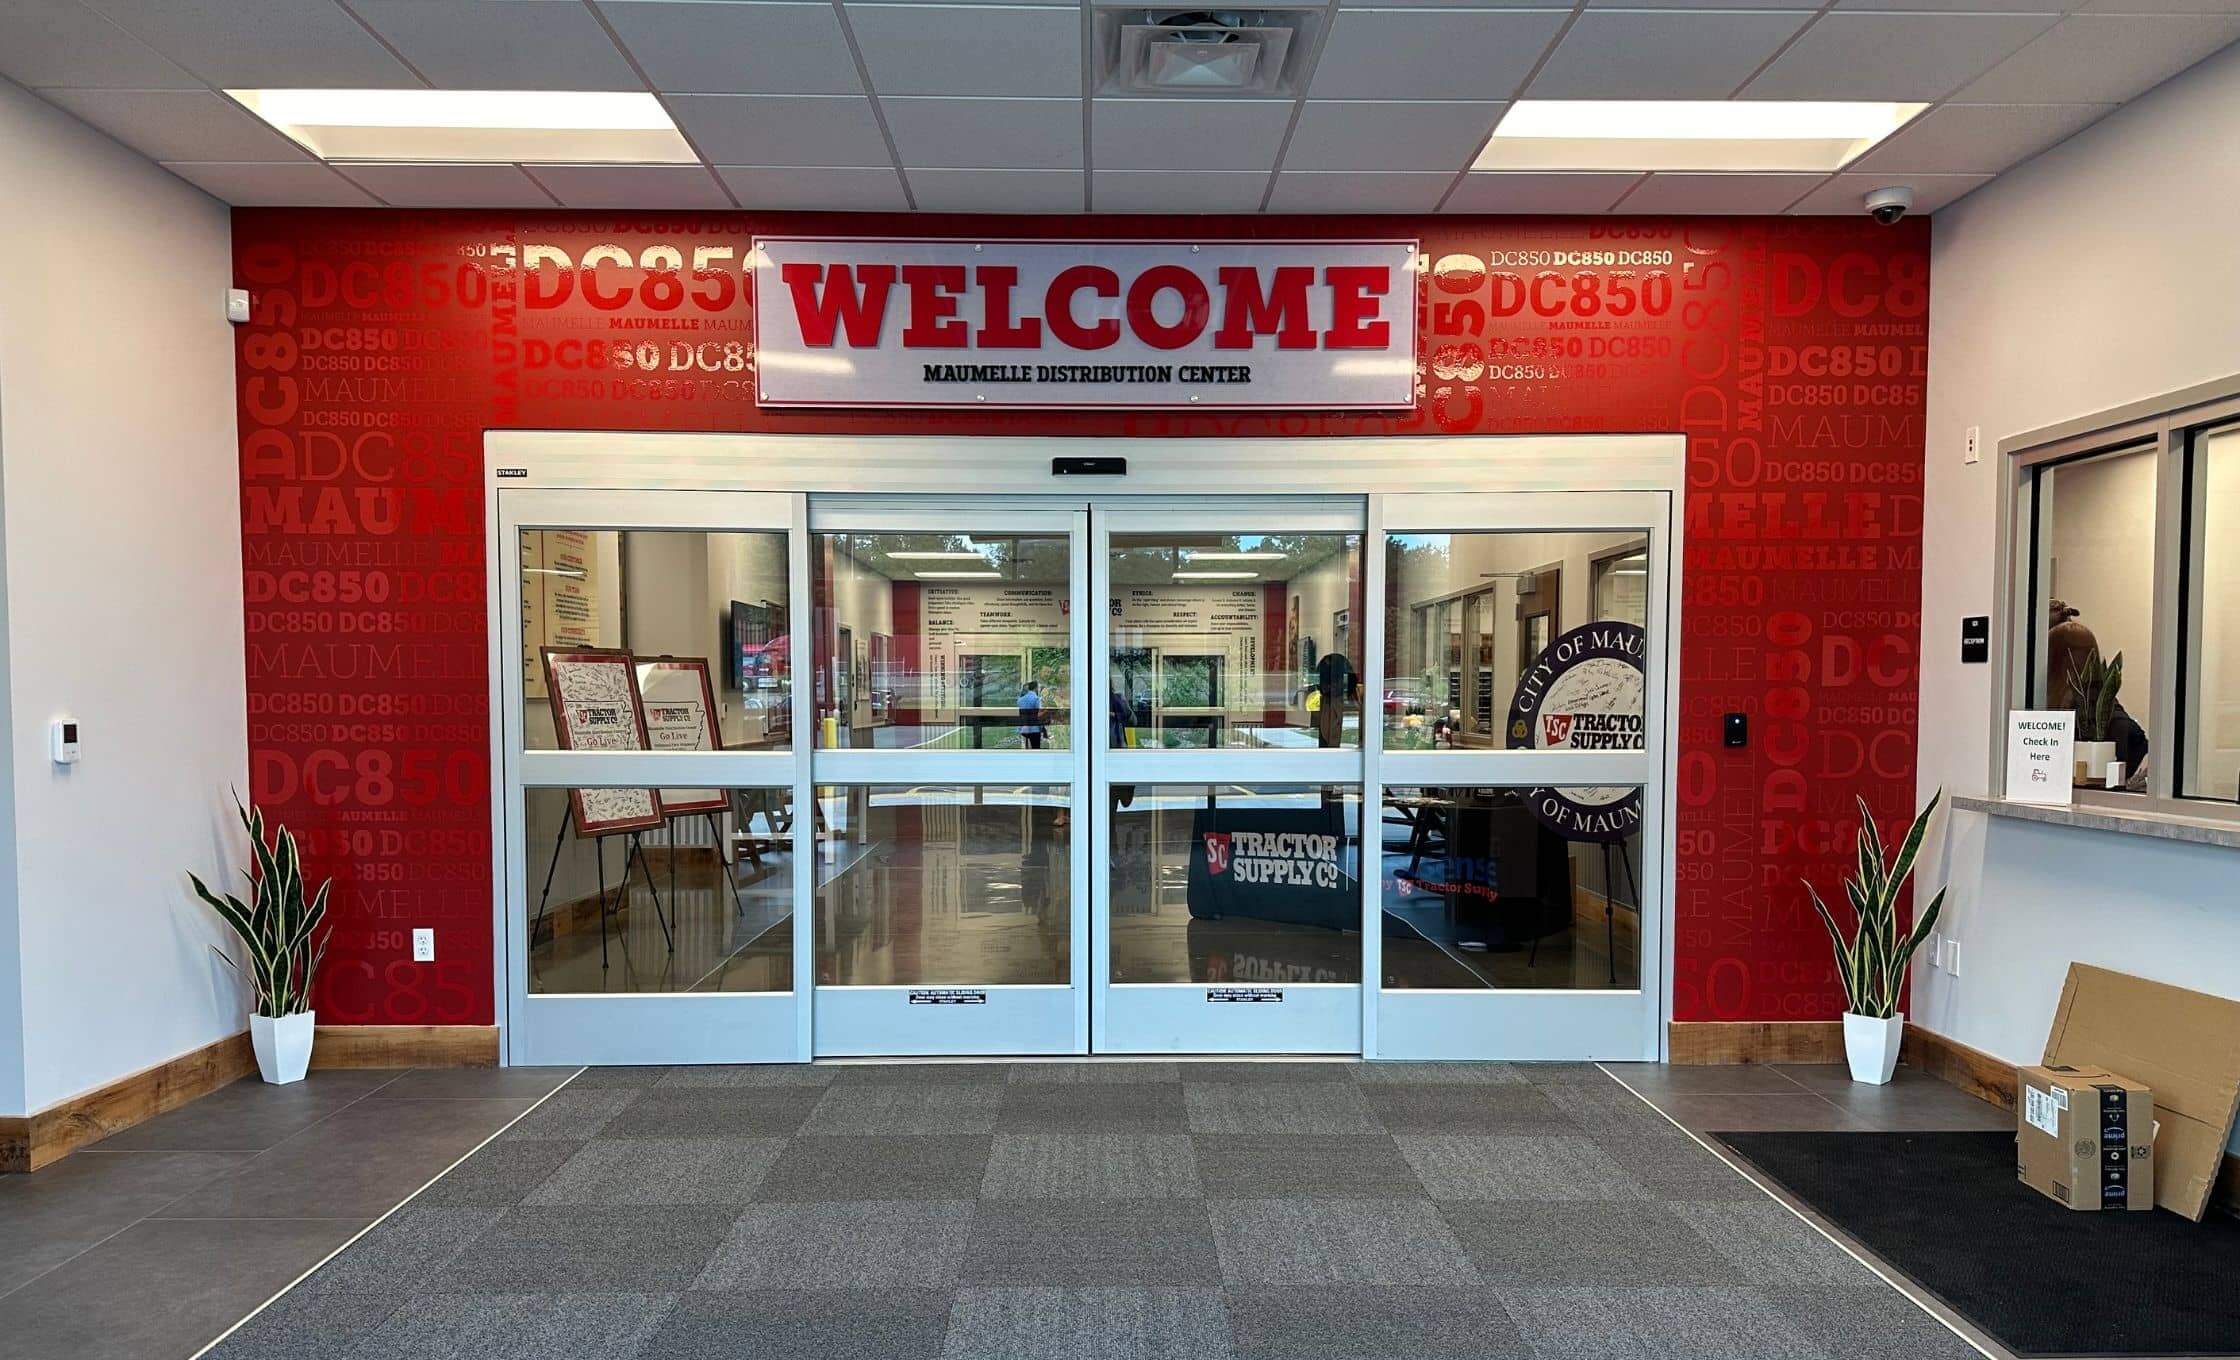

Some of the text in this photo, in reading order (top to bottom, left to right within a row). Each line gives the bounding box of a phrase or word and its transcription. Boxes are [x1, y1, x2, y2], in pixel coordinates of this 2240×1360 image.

[1491, 250, 1673, 266] DC850 DC850 DC850
[301, 260, 487, 309] DC850
[523, 244, 753, 311] DC85
[1491, 270, 1672, 317] DC850
[782, 263, 1390, 350] WELCOME
[608, 318, 699, 330] MAUMELLE
[1549, 320, 1611, 330] MAUMELLE
[301, 328, 398, 351] DC850
[1589, 336, 1672, 359] DC850
[244, 244, 298, 481] DC850
[303, 356, 361, 371] DC850
[523, 338, 660, 370] DC850
[1767, 346, 1903, 377] DC850
[923, 364, 1251, 383] MAUMELLE DISTRIBUTION CENTER
[1489, 365, 1545, 380] DC850
[1768, 384, 1848, 405] DC850
[303, 411, 361, 426] DC850
[1765, 461, 1845, 482] DC850
[246, 487, 484, 535] MAUM
[246, 570, 390, 603] DC850
[248, 612, 334, 633] DC850
[339, 612, 427, 633] DC850
[1518, 656, 1552, 713] CITY
[1556, 635, 1585, 662] OF
[1590, 630, 1643, 659] MAU
[249, 693, 334, 714] DC850
[339, 693, 427, 715] DC850
[587, 708, 616, 717] TRACTOR
[1763, 611, 1812, 813] DC850
[1816, 706, 1884, 724] DC850
[589, 716, 611, 724] SUPPLY
[1545, 716, 1567, 740] TSC
[1573, 714, 1642, 732] TRACTO
[2018, 721, 2066, 731] WELCOME!
[1570, 733, 1632, 749] SUPPLY
[2023, 737, 2059, 746] Check In
[2030, 752, 2050, 761] Here
[252, 749, 486, 806] DC850
[1542, 799, 1570, 824] OF
[1204, 833, 1228, 869] SC
[1231, 832, 1338, 862] TRACTOR
[1233, 858, 1315, 886] SUPPLY
[1416, 880, 1499, 902] Tractor Supply
